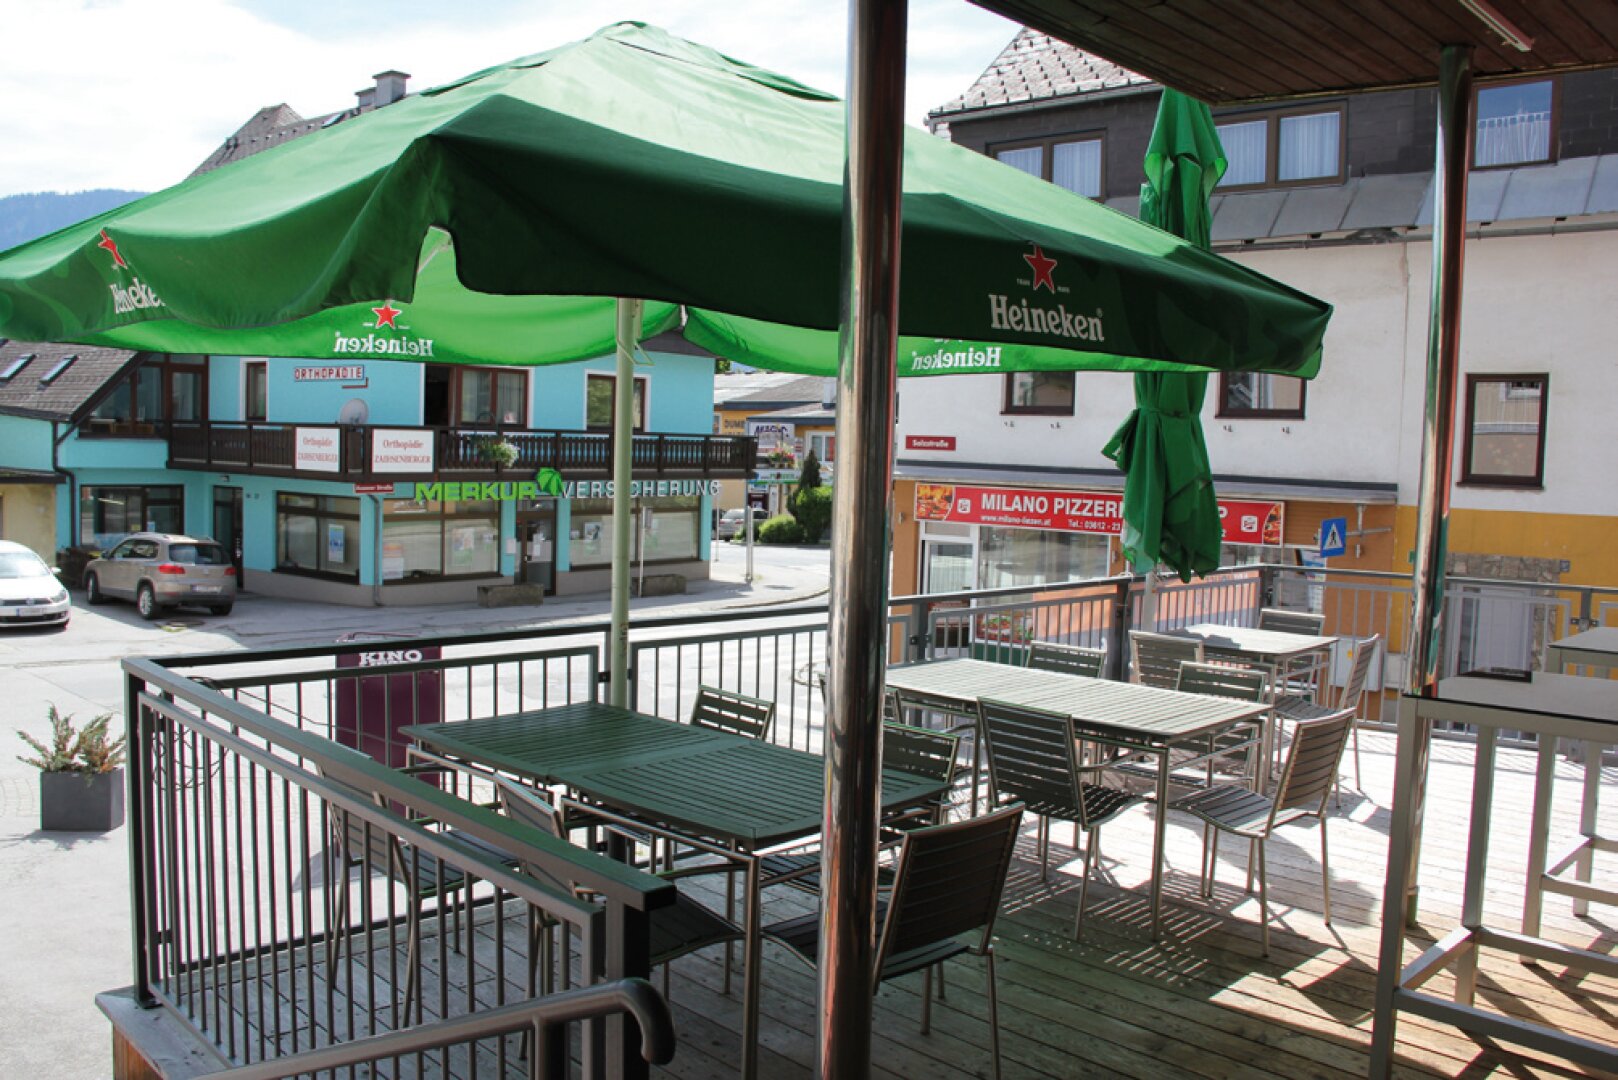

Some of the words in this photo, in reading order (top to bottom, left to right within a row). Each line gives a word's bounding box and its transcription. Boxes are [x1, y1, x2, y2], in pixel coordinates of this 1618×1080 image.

[988, 294, 1104, 342] Heineken
[382, 439, 424, 452] Orthopädie
[414, 482, 537, 502] MERKUR
[562, 480, 721, 499] VERSCHERUNG
[981, 493, 1049, 514] MILANO
[1054, 497, 1123, 518] PIZZERI
[359, 650, 422, 667] KINO
